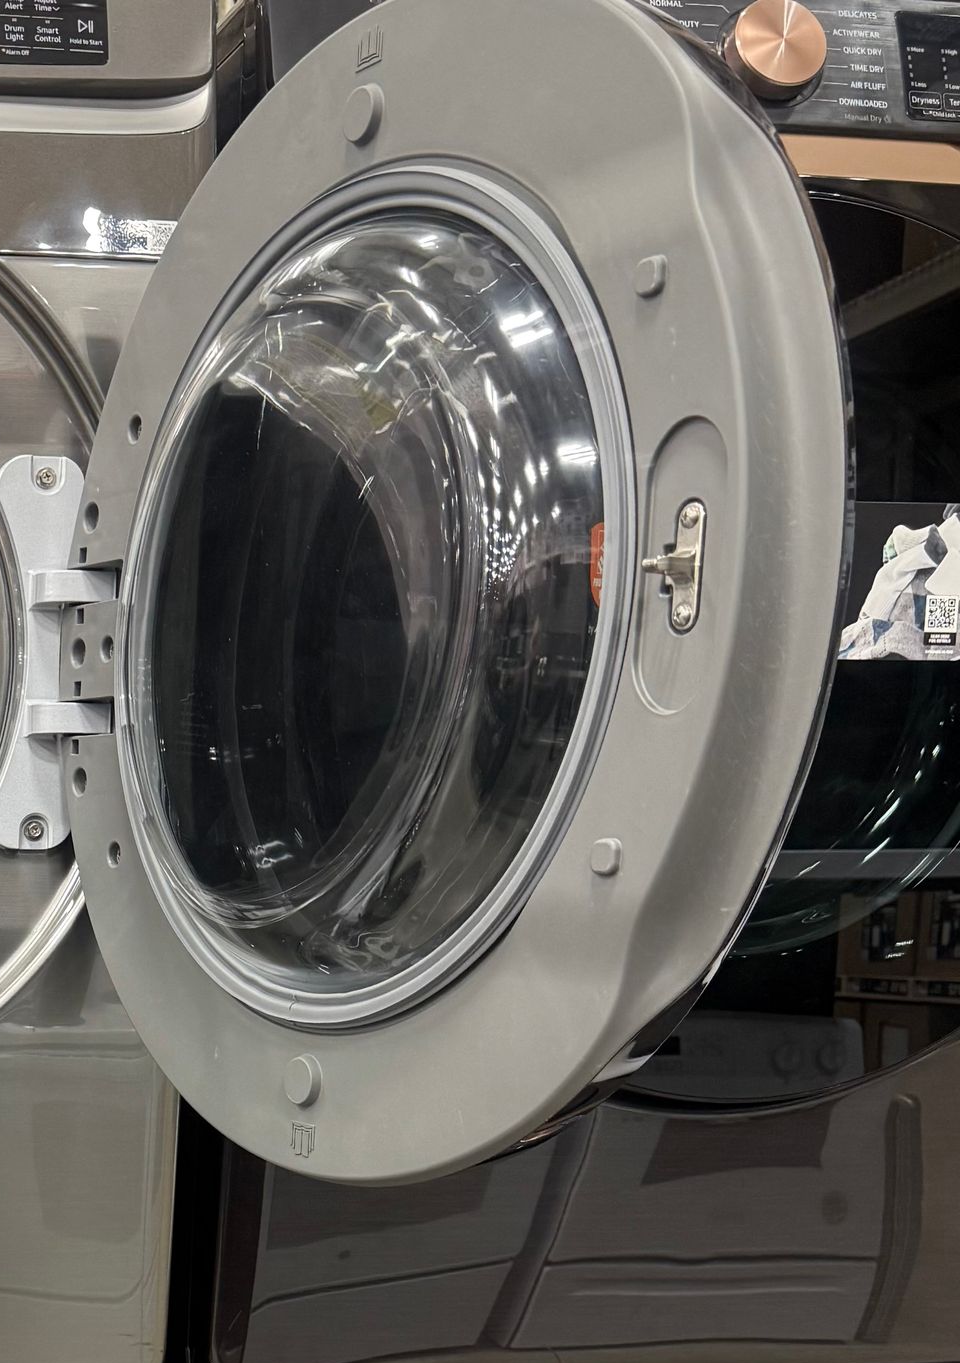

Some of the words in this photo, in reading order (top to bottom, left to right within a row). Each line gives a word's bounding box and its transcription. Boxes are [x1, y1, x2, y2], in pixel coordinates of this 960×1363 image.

[5, 2, 23, 10] Alert
[838, 10, 878, 20] DELICATES
[4, 24, 25, 33] Drum
[36, 26, 59, 34] Smart
[832, 28, 880, 39] ACTIVEWEAR
[5, 32, 24, 41] Light
[34, 36, 61, 44] Control
[843, 47, 867, 55] QUICK
[867, 48, 882, 57] DRY
[849, 63, 869, 72] TIME
[869, 65, 884, 74] DRY
[850, 81, 863, 89] AIR
[864, 82, 886, 91] FLUFF
[838, 98, 888, 109] DOWNLOADED
[911, 95, 940, 106] Dryness
